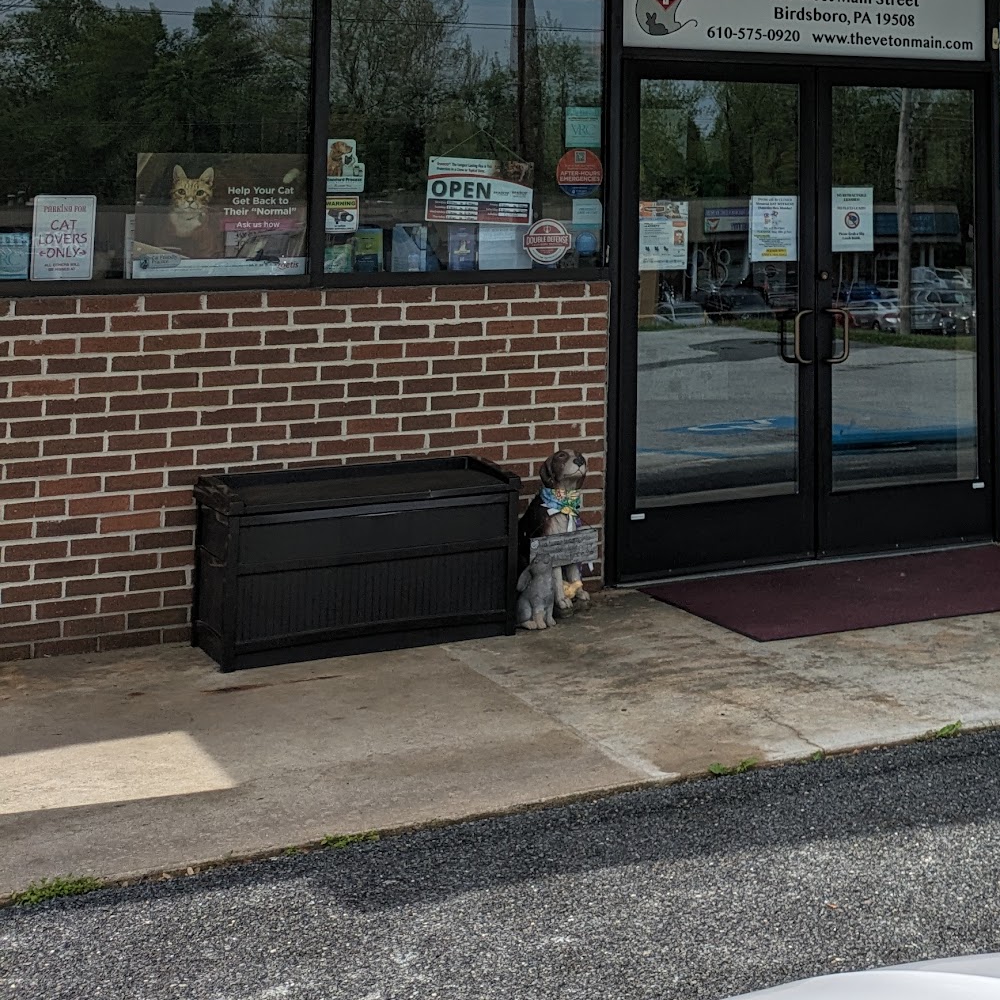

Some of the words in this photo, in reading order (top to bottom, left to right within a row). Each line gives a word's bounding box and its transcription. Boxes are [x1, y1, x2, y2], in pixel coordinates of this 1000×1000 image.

[775, 6, 850, 25] Birdsboro,
[854, 12, 871, 24] PA
[876, 13, 914, 26] 19508
[707, 26, 800, 42] 610-575-0920
[812, 32, 973, 50] www.thevetonmain.com
[228, 186, 250, 197] Help
[253, 186, 275, 195] Your
[277, 186, 294, 195] Cat
[431, 180, 491, 199] OPEN
[232, 197, 250, 205] Get
[253, 197, 276, 205] Back
[278, 197, 289, 205] to
[223, 207, 248, 216] Their
[50, 219, 77, 231] CAT
[236, 221, 251, 229] Ask
[264, 221, 280, 229] how
[39, 233, 88, 245] LOVERS
[526, 235, 547, 245] DOUBLE
[547, 235, 569, 245] DEFENSE
[46, 246, 79, 259] ONLY
